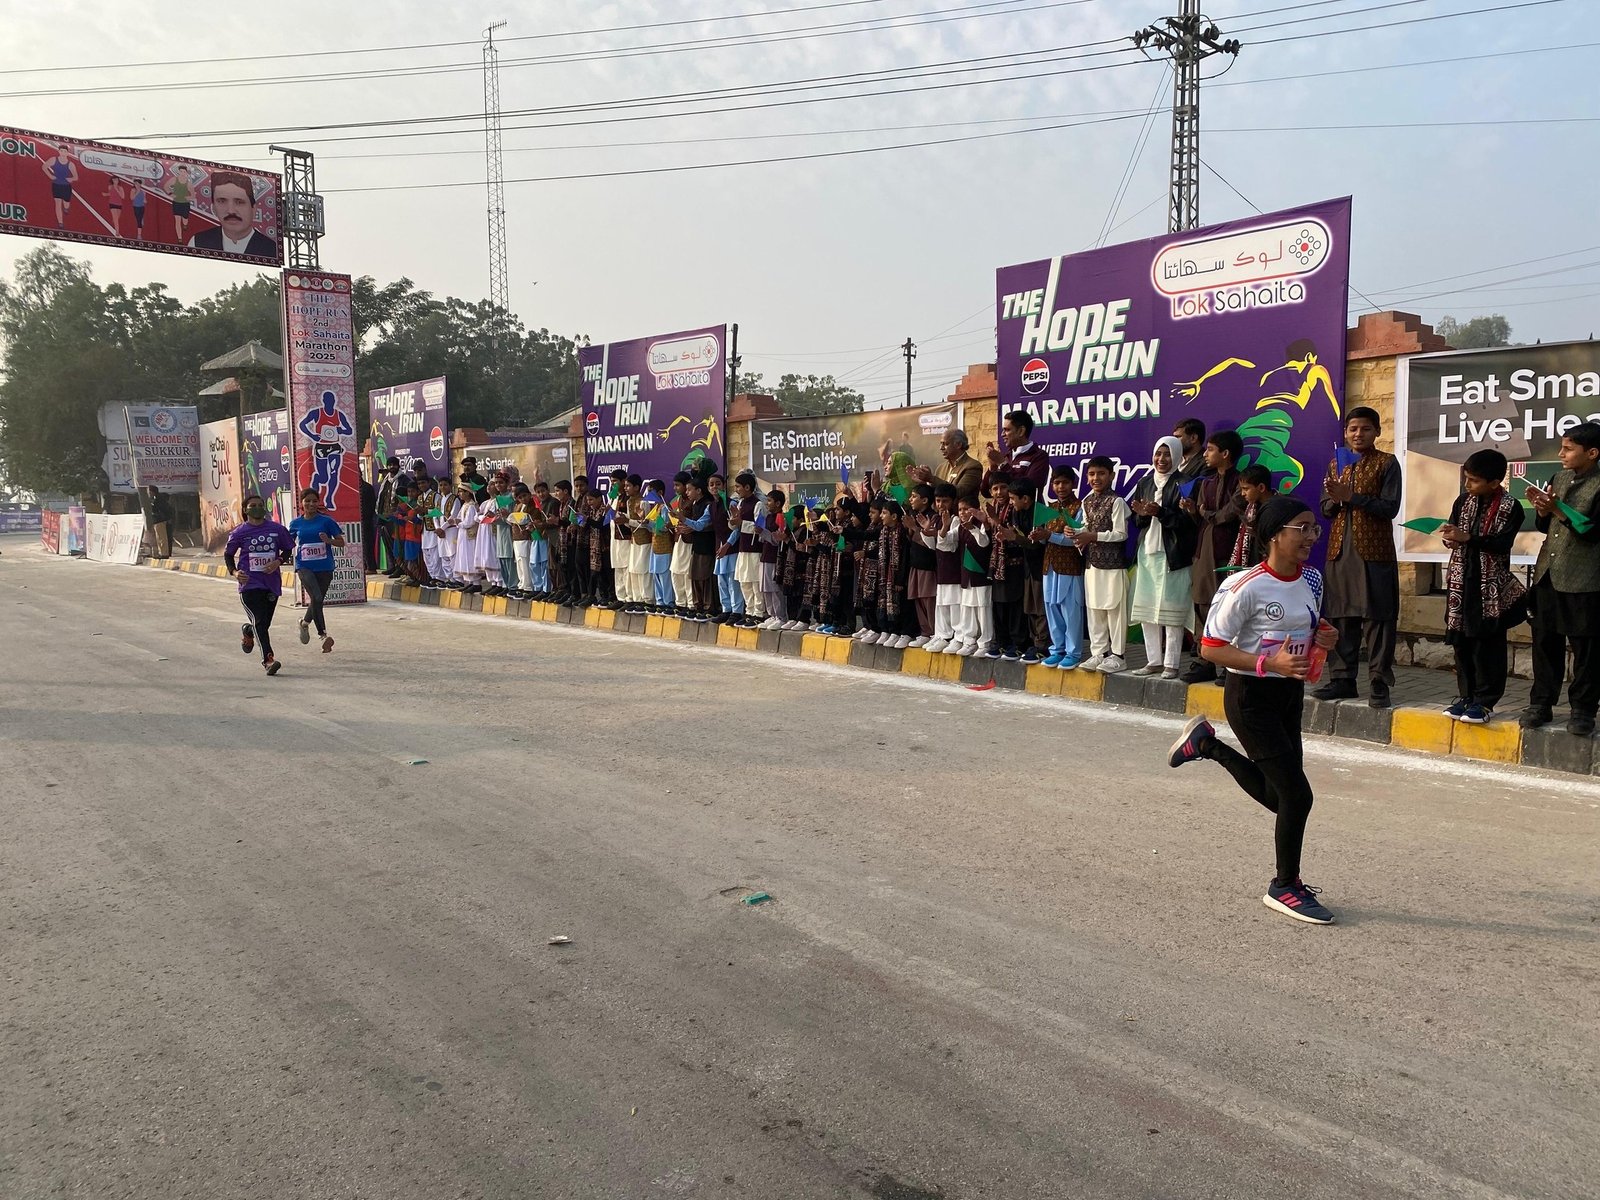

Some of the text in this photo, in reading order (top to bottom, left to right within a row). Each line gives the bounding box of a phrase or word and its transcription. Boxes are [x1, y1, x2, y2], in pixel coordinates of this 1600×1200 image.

[0, 138, 36, 159] ON
[1002, 288, 1045, 320] THE
[1173, 281, 1304, 317] Lok Sahaita
[313, 318, 329, 327] 2nd
[292, 329, 350, 340] Lok Sahaita
[295, 341, 348, 351] Marathon
[310, 352, 336, 360] 2025
[1080, 339, 1160, 384] RUN
[583, 364, 602, 382] THE
[656, 371, 709, 388] Lok Sahaita
[1023, 371, 1048, 381] PEPSI
[1440, 374, 1501, 406] Eat
[374, 396, 386, 409] THE
[1002, 389, 1161, 427] MARATHON
[621, 401, 652, 425] RUN
[403, 412, 424, 433] RUN
[1438, 408, 1600, 444] Live He
[135, 435, 197, 444] WELCOME TO
[431, 439, 443, 447] PEPS
[587, 433, 652, 453] MARATHON
[762, 429, 846, 450] Eat Smarter,
[144, 446, 191, 456] SUKKUR
[1038, 441, 1096, 456] WERED BY
[136, 458, 167, 467] NATIONAL
[167, 458, 185, 467] PRESS
[475, 459, 485, 470] at
[763, 450, 858, 472] Live Healthier
[333, 547, 345, 557] WN
[334, 559, 354, 568] CIPAL
[334, 570, 360, 580] RATION
